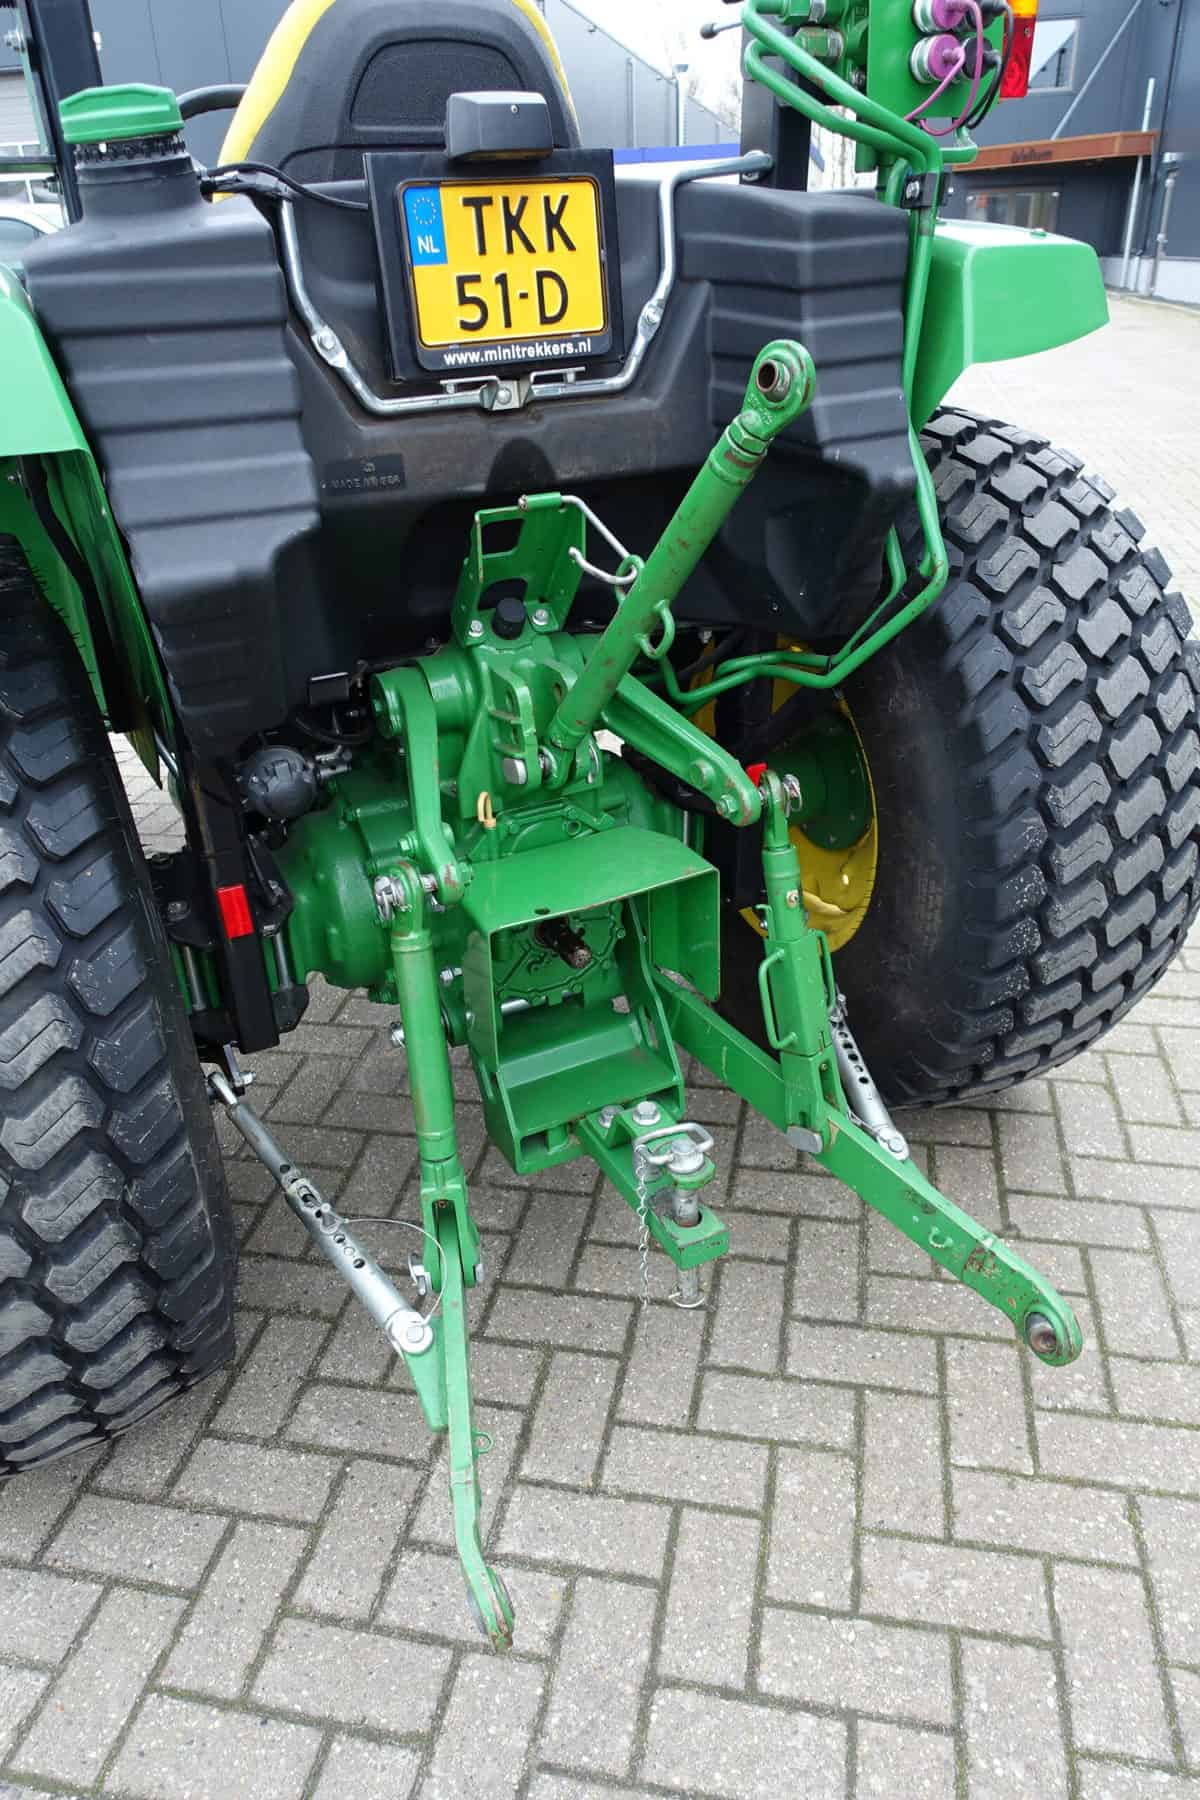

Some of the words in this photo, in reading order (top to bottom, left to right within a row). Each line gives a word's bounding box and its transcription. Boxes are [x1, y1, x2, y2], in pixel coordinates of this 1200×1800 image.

[416, 235, 441, 254] NL
[462, 195, 577, 256] TKK
[455, 270, 569, 331] 51-D
[443, 338, 592, 365] www.minitrekkers.nl
